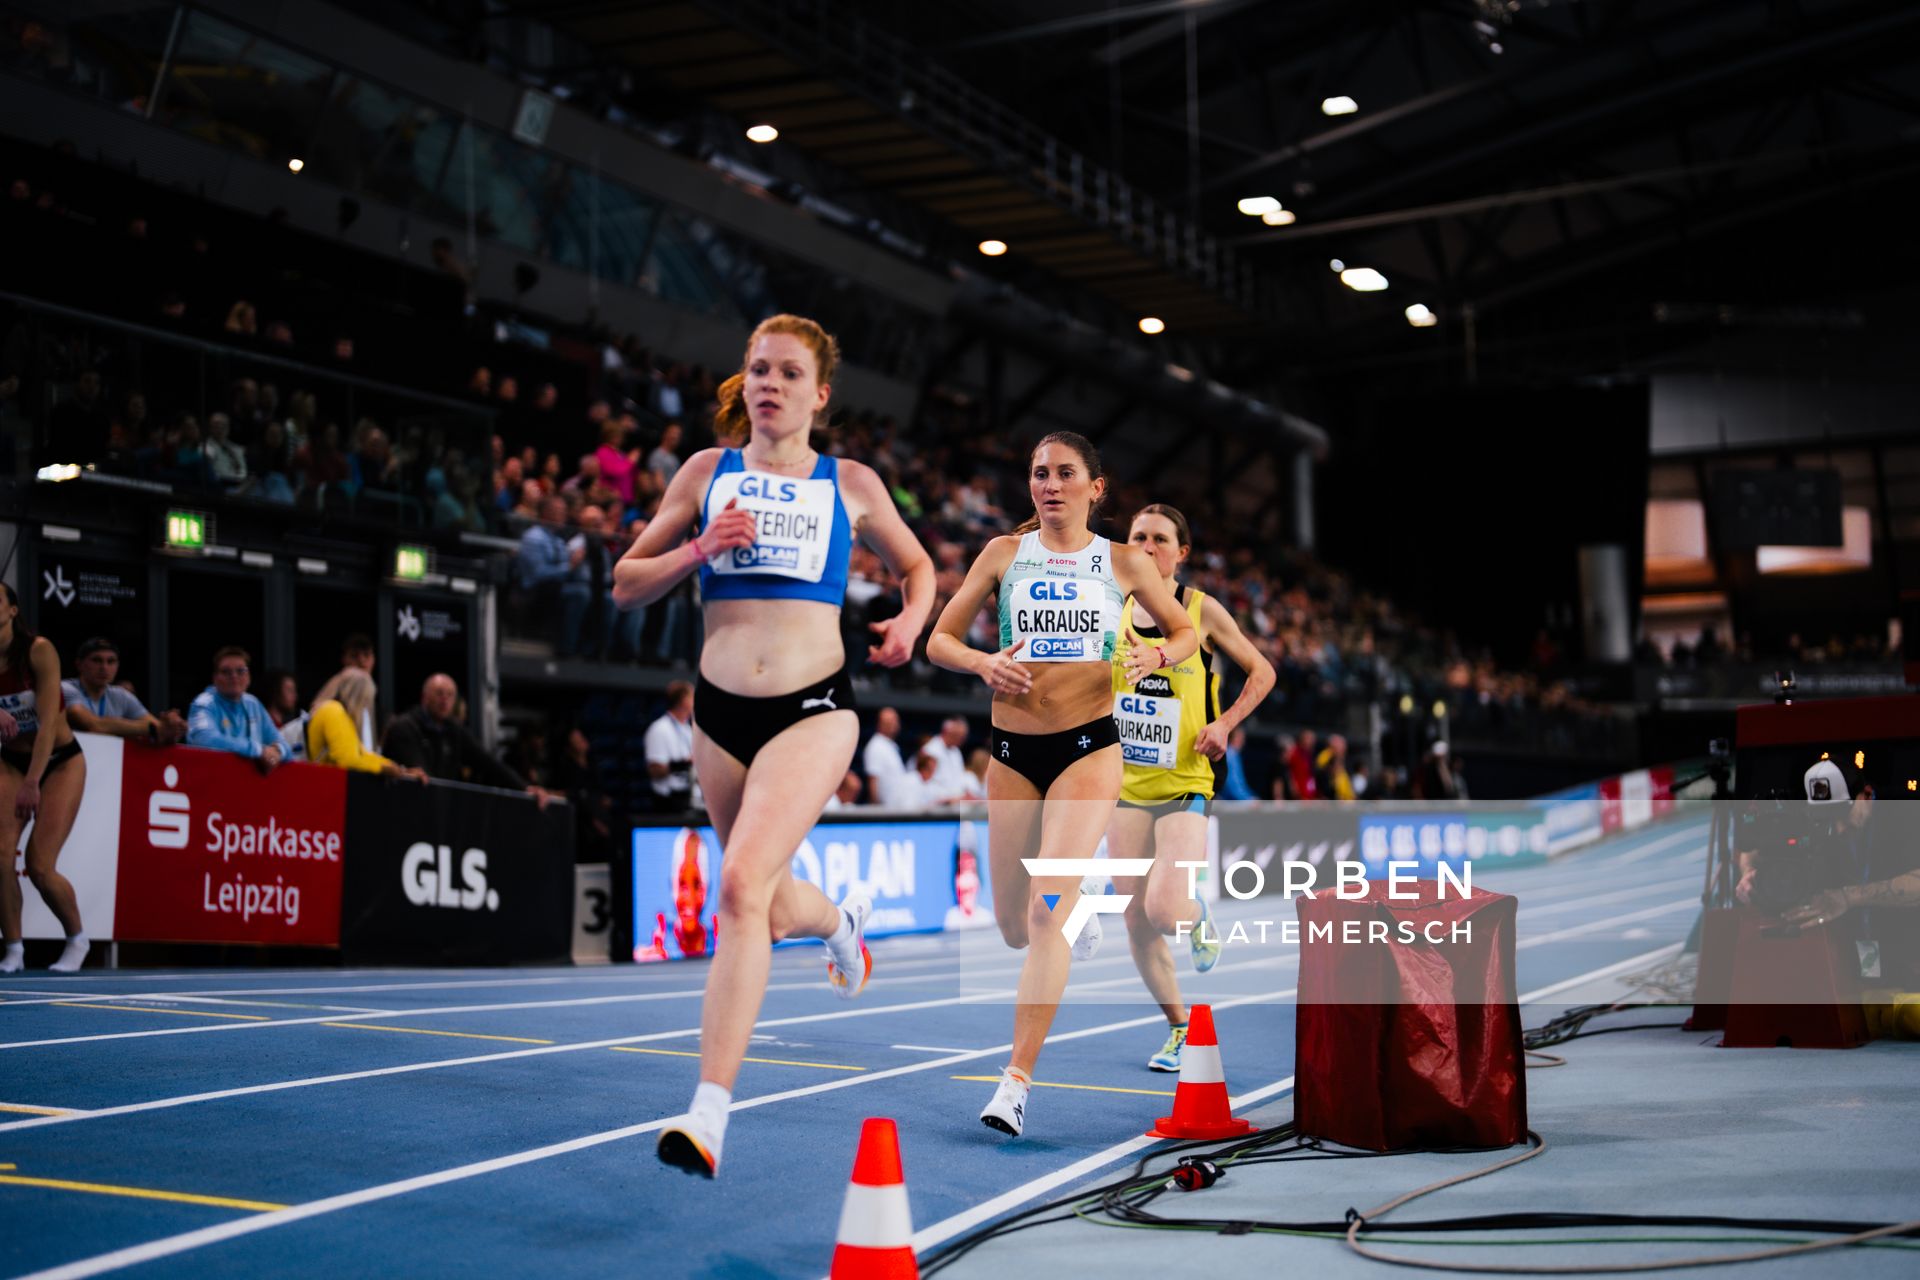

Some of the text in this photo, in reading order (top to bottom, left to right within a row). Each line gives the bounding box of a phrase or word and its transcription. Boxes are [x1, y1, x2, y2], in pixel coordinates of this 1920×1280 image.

[1055, 558, 1077, 566] LOTTO
[1045, 569, 1067, 577] Allianz
[1017, 610, 1100, 633] G.KRAUSE
[1052, 640, 1082, 651] PLAN
[1139, 678, 1169, 690] HOKA
[1134, 748, 1158, 758] PLAN
[205, 812, 341, 862] Sparkasse
[824, 839, 916, 901] PLAN
[203, 872, 301, 925] Leipzig
[581, 887, 610, 935] 3
